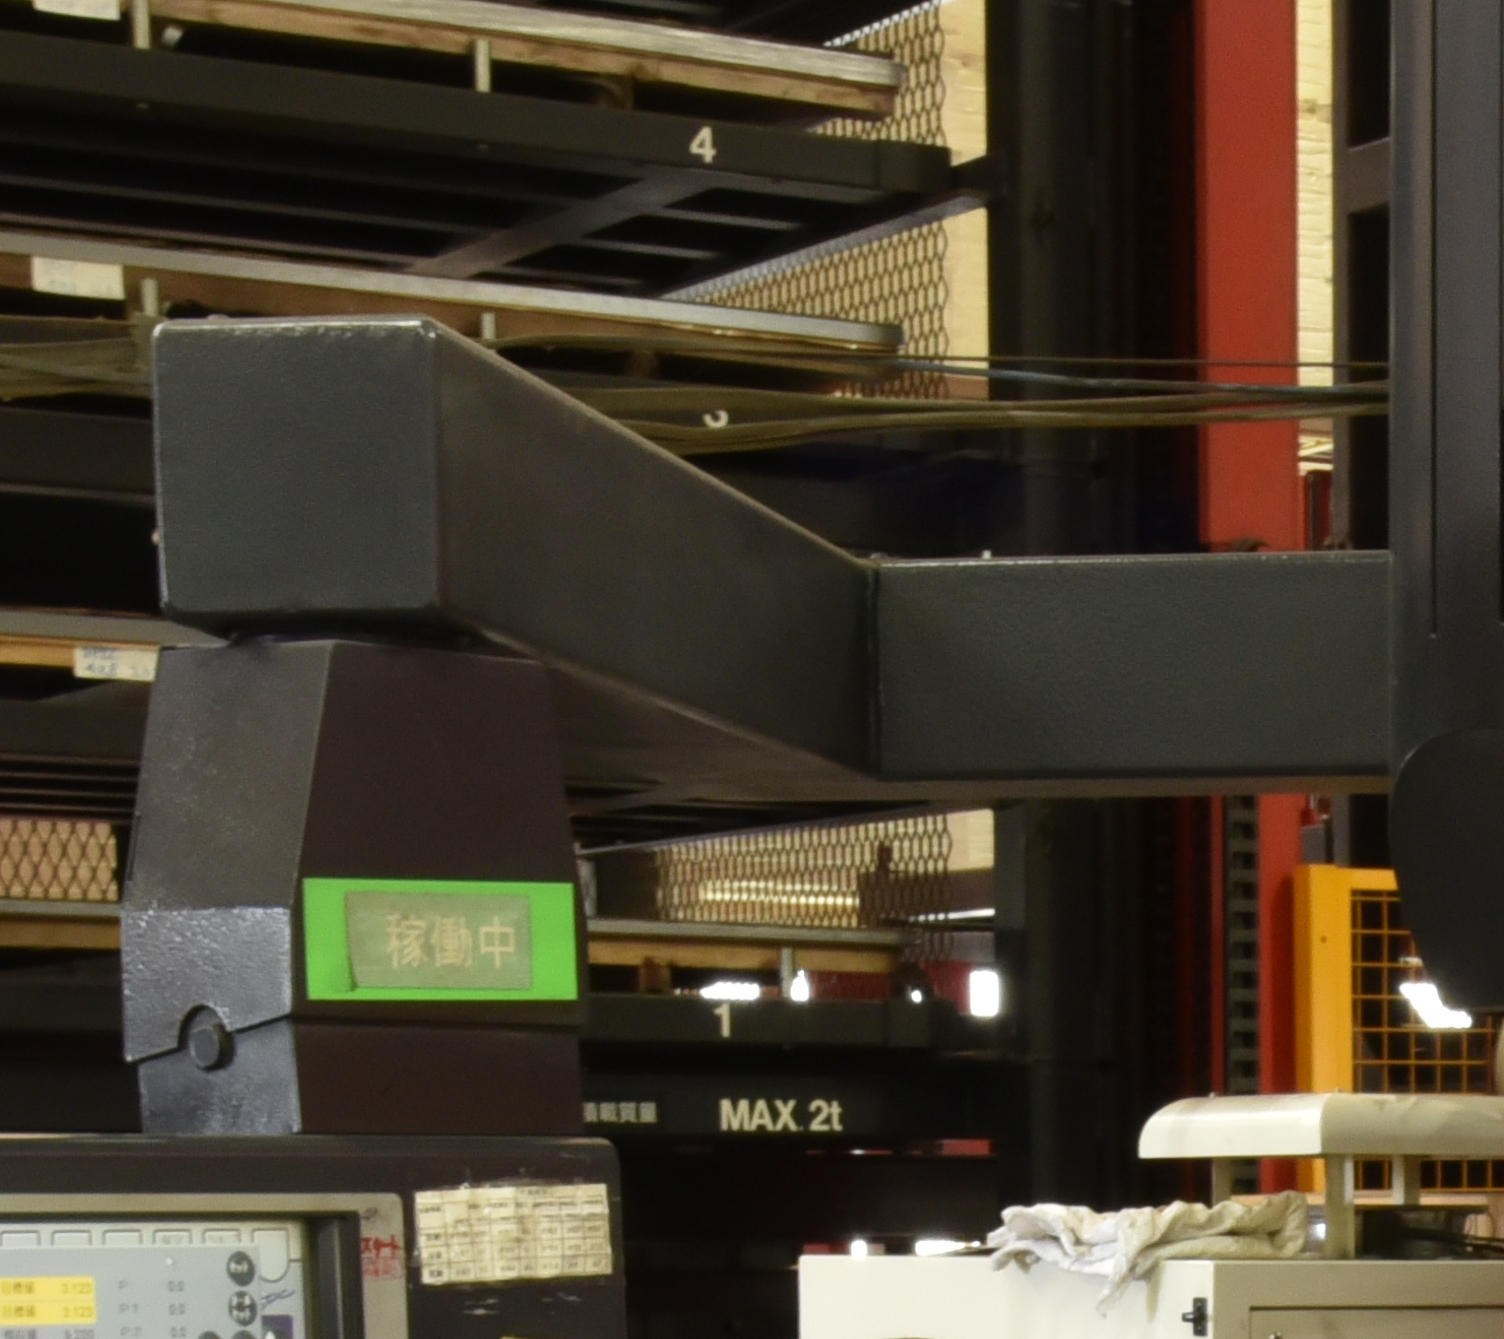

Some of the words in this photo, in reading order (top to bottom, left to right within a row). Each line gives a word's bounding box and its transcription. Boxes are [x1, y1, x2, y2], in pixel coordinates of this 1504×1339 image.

[689, 125, 717, 163] 4
[385, 915, 518, 969] 稼働中
[713, 1004, 733, 1038] 1
[808, 1098, 843, 1132] 2t
